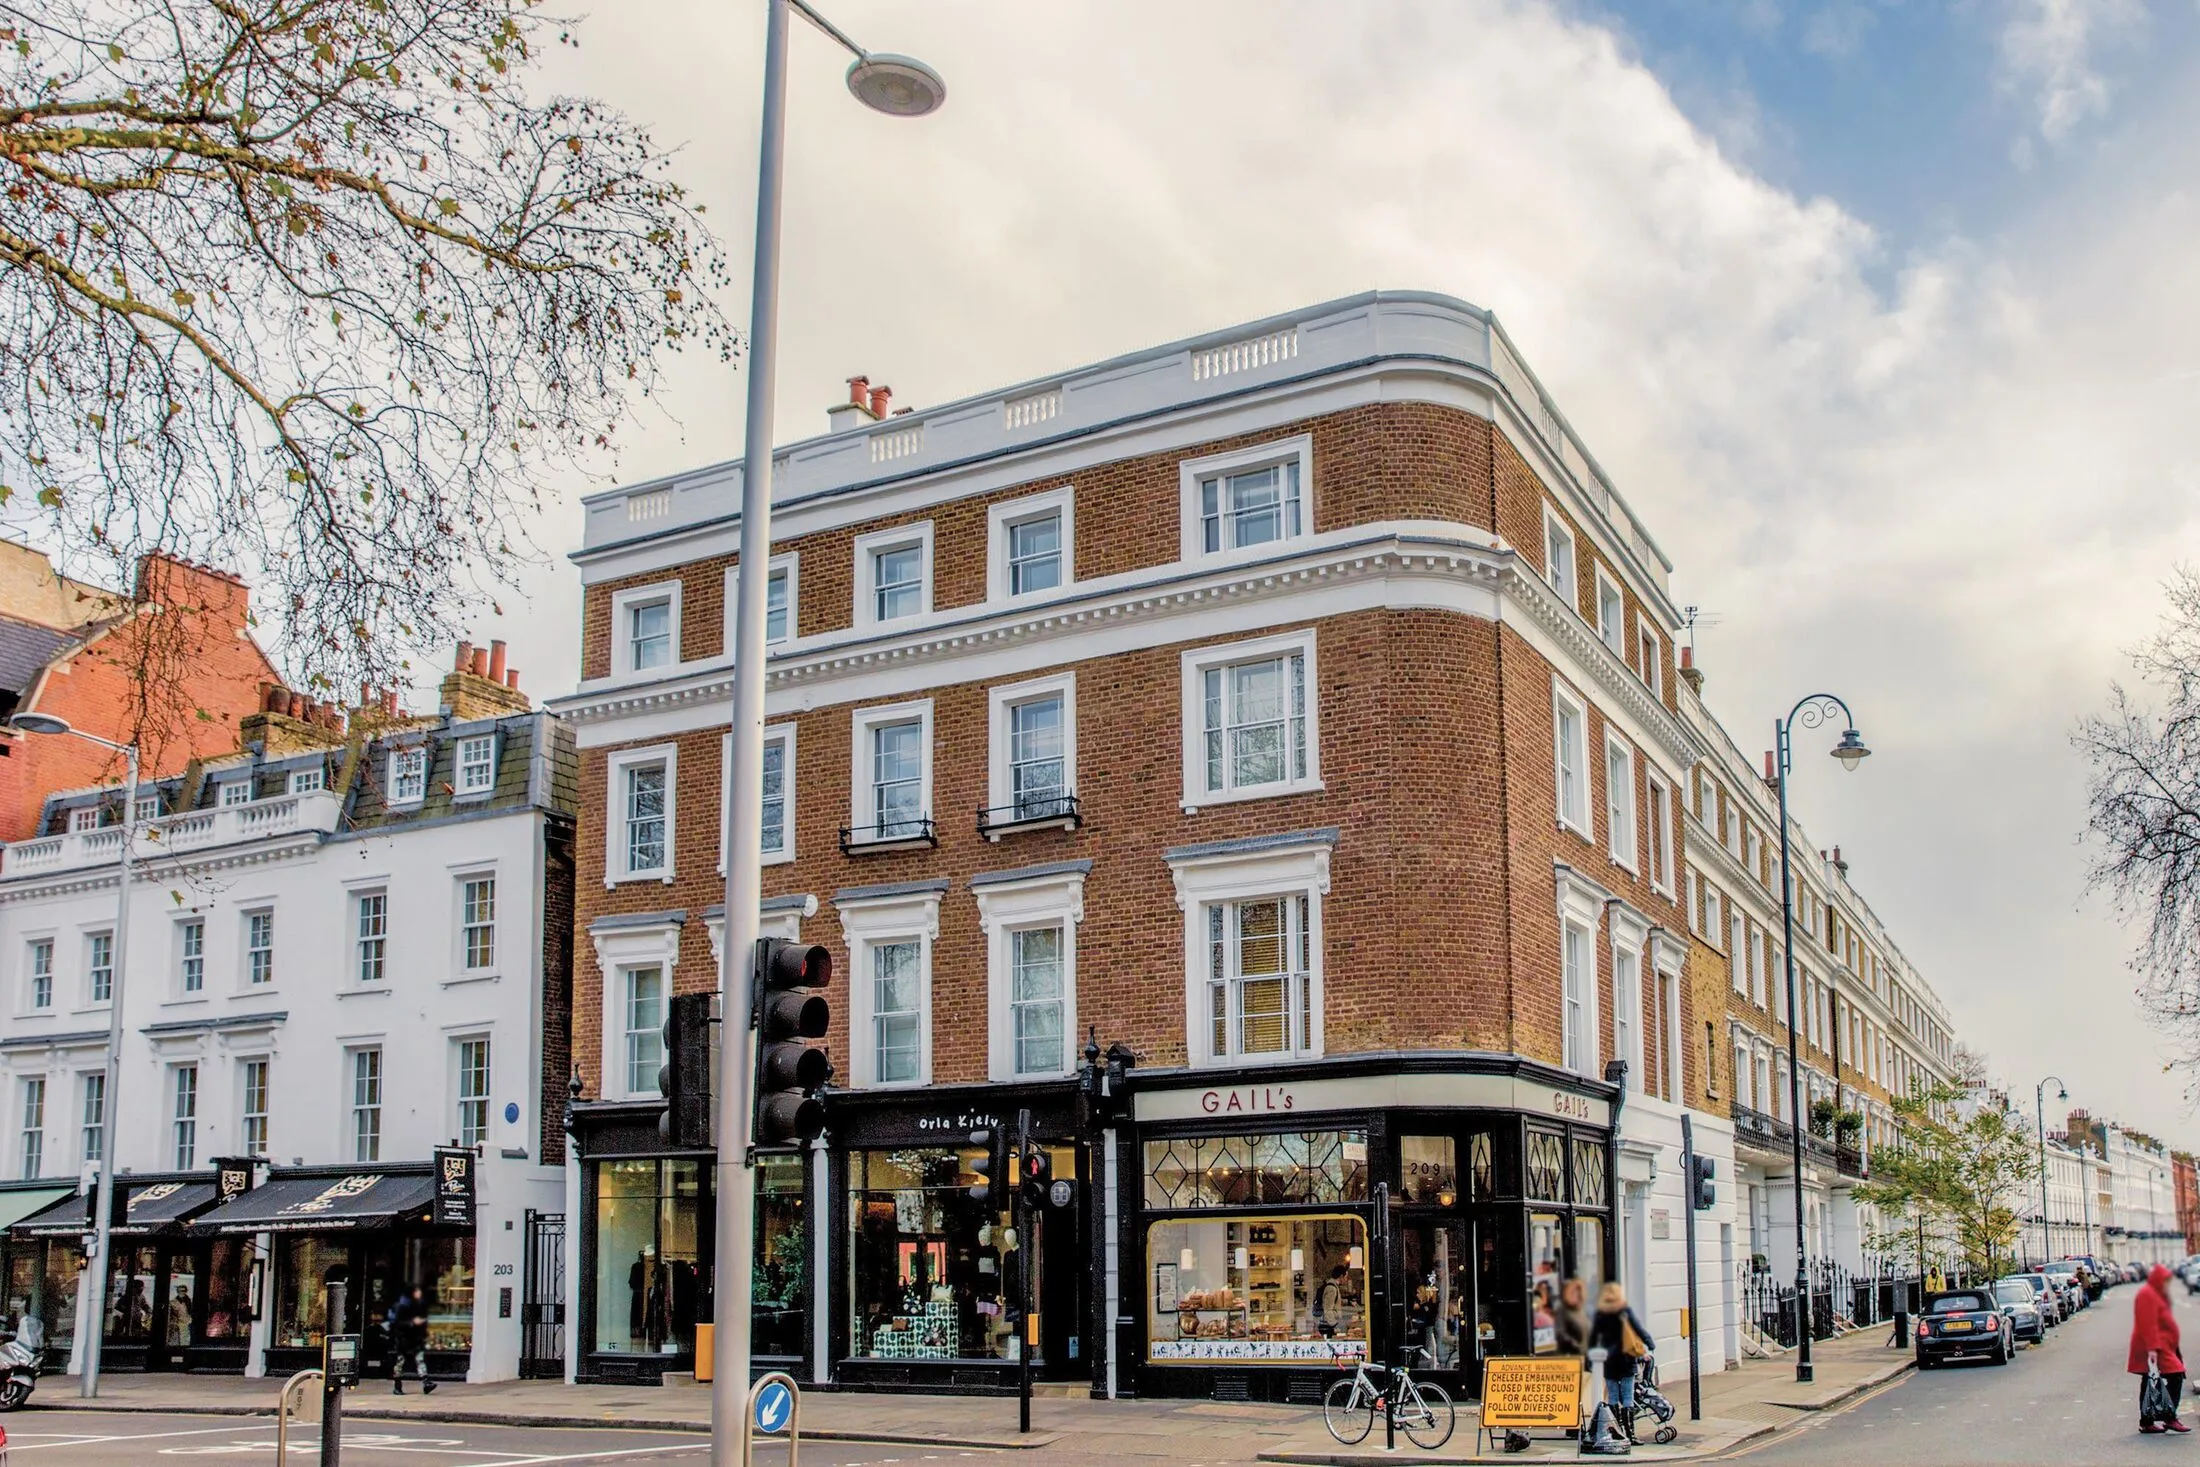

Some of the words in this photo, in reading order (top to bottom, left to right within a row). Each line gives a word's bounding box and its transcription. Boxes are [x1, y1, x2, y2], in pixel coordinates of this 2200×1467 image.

[1202, 1088, 1293, 1113] GAIL's
[919, 1117, 950, 1130] Orla
[1410, 1162, 1440, 1176] 209
[494, 1264, 514, 1276] 203
[1491, 1373, 1523, 1383] CHELSEA
[1525, 1373, 1575, 1383] EMBANKMENT
[1491, 1384, 1522, 1393] CLOSED
[1524, 1384, 1575, 1393] WESTBOUND
[1502, 1394, 1520, 1402] FOR
[1522, 1394, 1557, 1402] ACCESS
[1487, 1403, 1521, 1412] FOLLOW
[1523, 1403, 1571, 1412] DIVERSION
